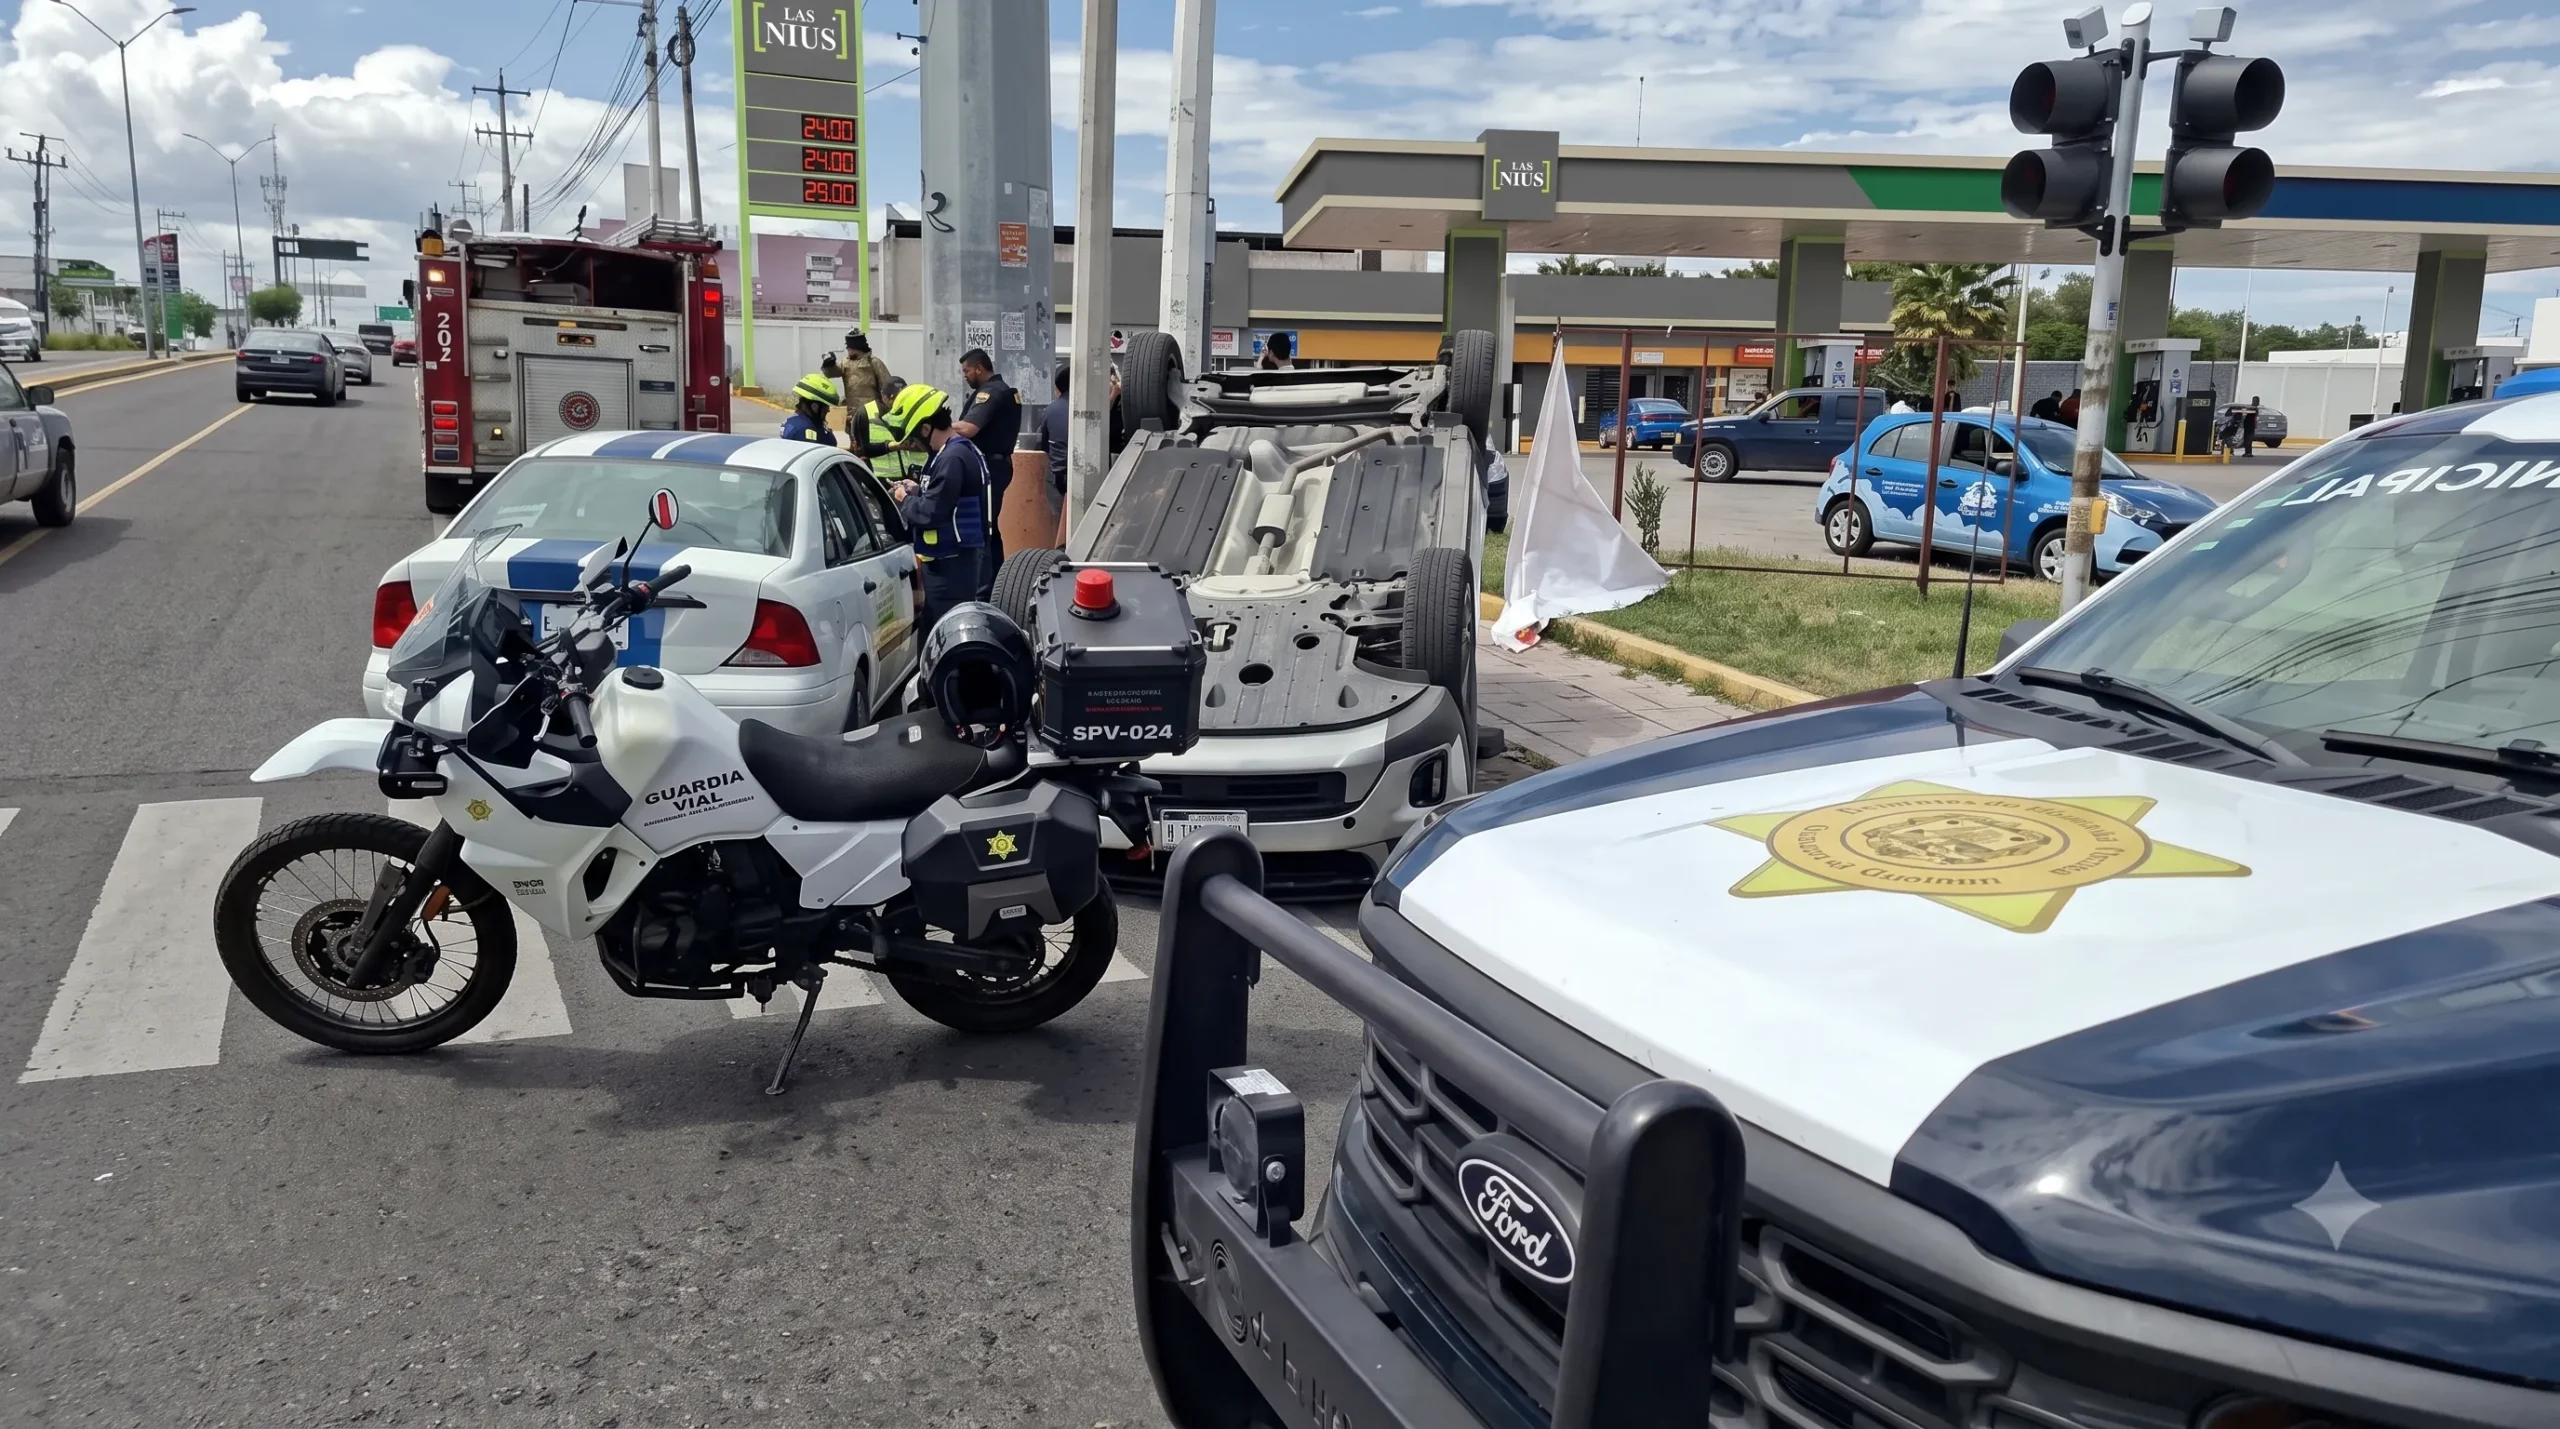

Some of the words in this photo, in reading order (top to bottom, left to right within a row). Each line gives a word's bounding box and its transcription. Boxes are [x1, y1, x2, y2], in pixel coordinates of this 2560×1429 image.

[784, 7, 815, 23] LAS
[765, 22, 837, 51] NIUS
[804, 117, 853, 141] 24.00
[804, 149, 854, 173] 24.00
[1512, 162, 1533, 171] LAS
[1500, 171, 1544, 187] NIUS
[1073, 724, 1173, 741] SPV-024
[645, 770, 745, 805] GUARDIA
[672, 792, 723, 812] VIAL
[1477, 1175, 1552, 1267] Ford
